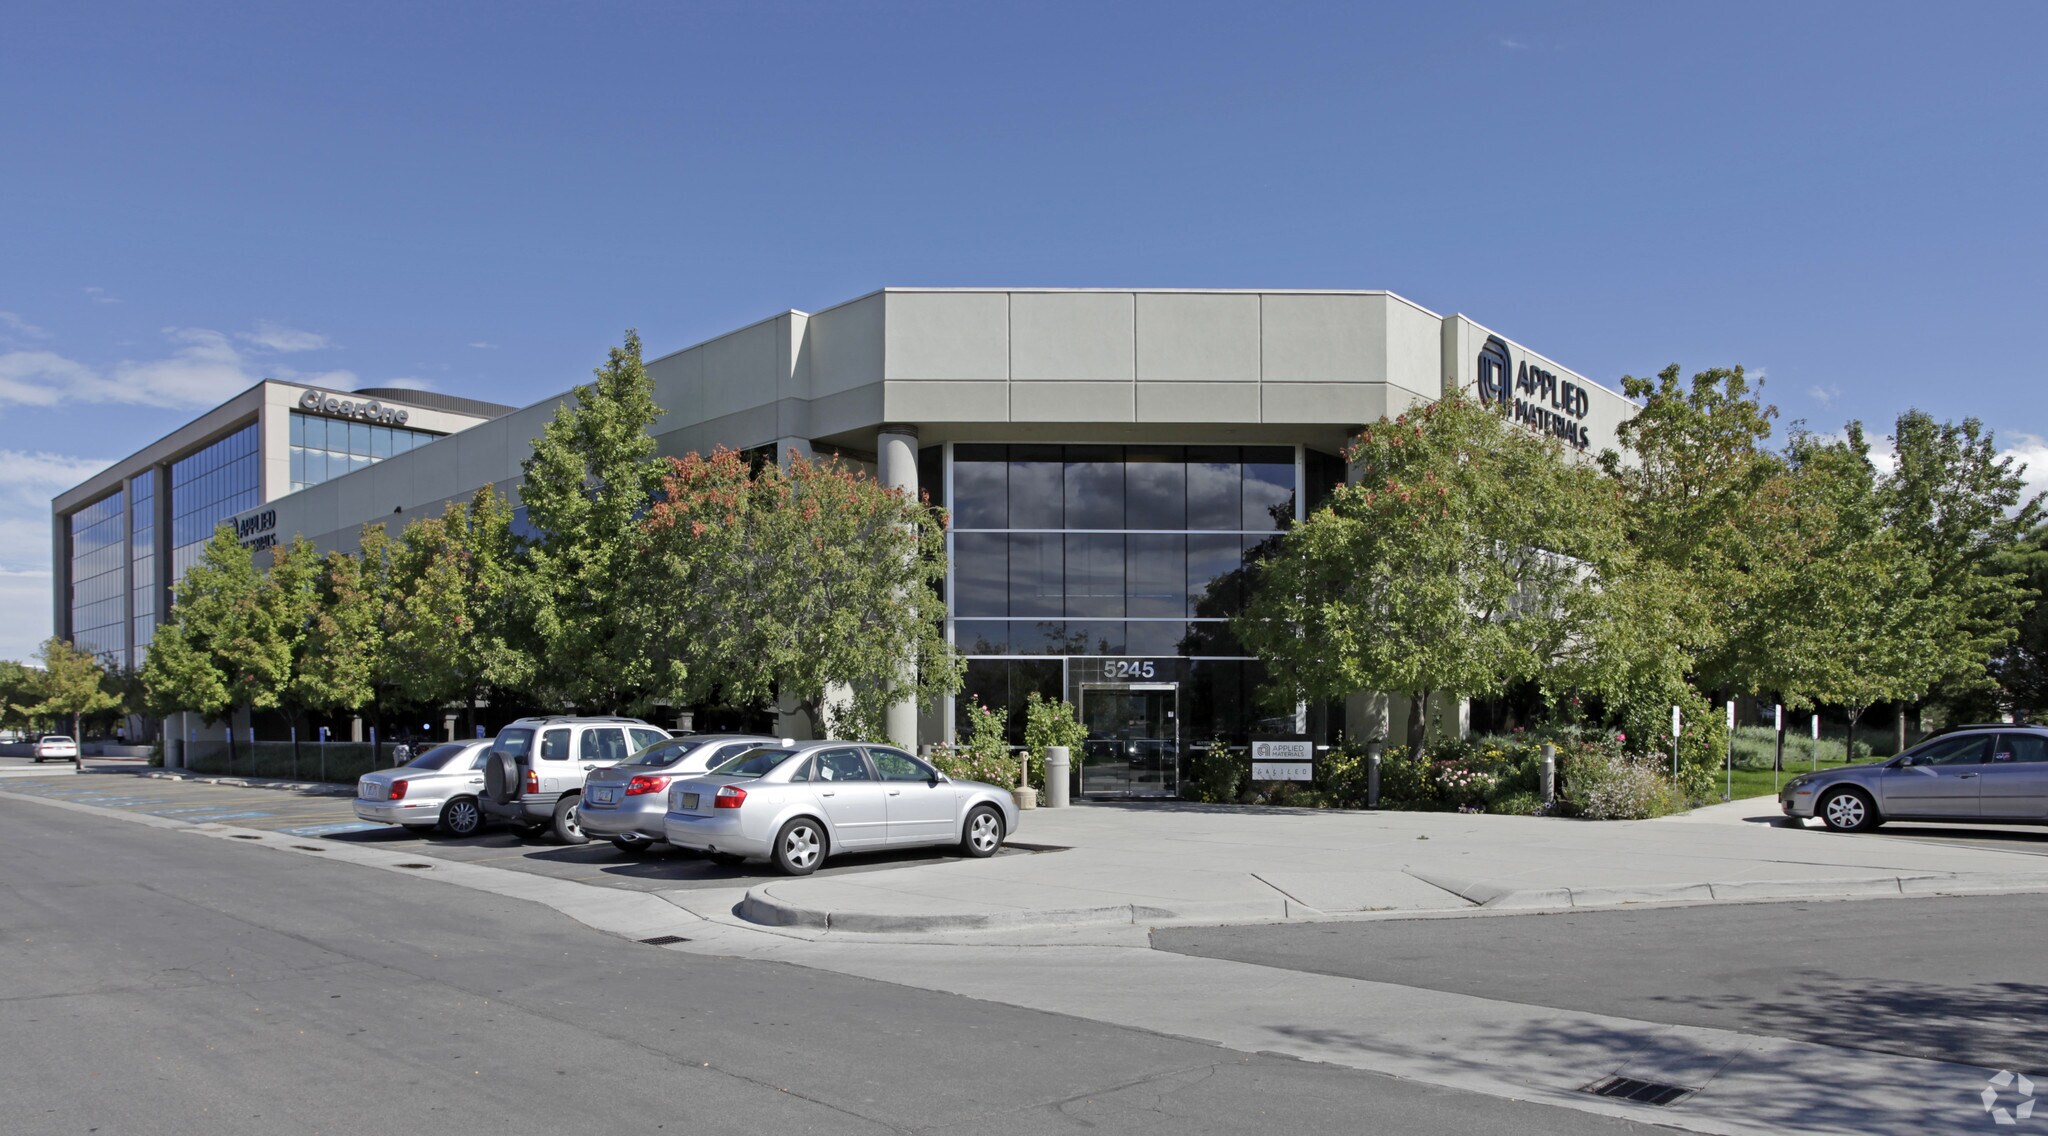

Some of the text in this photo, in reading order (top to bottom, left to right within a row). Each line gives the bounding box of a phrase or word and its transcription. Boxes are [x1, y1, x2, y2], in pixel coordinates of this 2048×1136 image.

[1515, 360, 1589, 420] APPLIED
[299, 389, 409, 423] ClearOne
[240, 509, 277, 538] APPLIED
[1103, 660, 1155, 678] 5245
[1272, 744, 1305, 752] APPLIED
[1257, 768, 1307, 776] GALILEO
